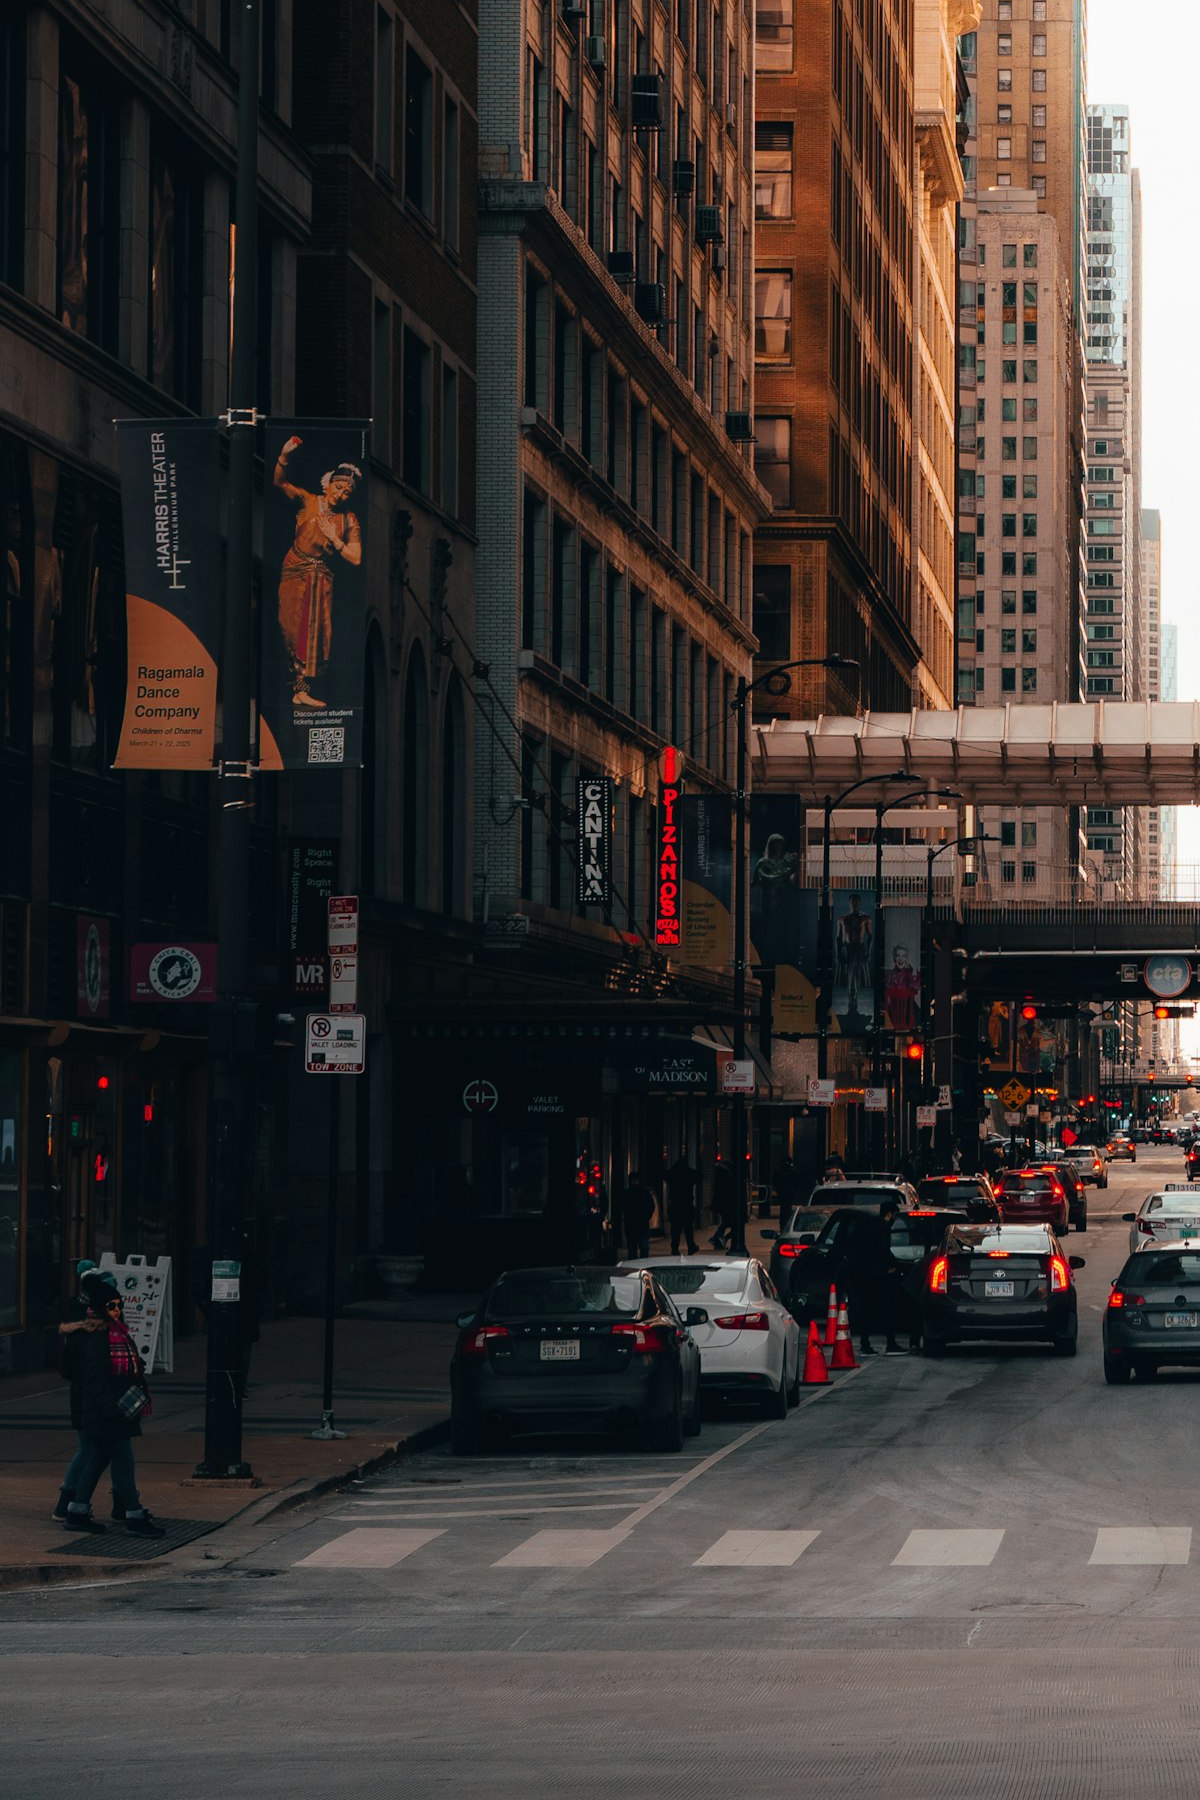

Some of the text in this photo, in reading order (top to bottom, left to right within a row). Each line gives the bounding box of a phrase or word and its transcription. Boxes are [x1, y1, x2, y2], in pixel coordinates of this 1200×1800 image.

[151, 432, 171, 568] HARRIS THEATER
[169, 462, 179, 552] MILLENNIUM PARK
[137, 665, 205, 682] Ragamala
[136, 685, 180, 699] Dance
[134, 704, 200, 721] Company
[293, 709, 354, 718] Discounted student
[131, 727, 203, 736] Children of Dharma
[584, 784, 604, 897] CANTINA
[697, 799, 706, 868] HARRIS THEATER
[307, 848, 333, 858] Right
[306, 878, 332, 888] Right
[290, 848, 301, 951] www.marcrealty.com
[656, 918, 680, 930] PIZZA
[656, 931, 680, 945] PASTA
[154, 949, 197, 965] CHIYA CHAI
[296, 964, 325, 984] MR
[1151, 965, 1184, 981] cta
[158, 986, 192, 997] CHICAGO
[310, 1063, 359, 1071] TOW ZONE
[648, 1071, 708, 1082] MADISON
[532, 1095, 559, 1104] VALET
[527, 1105, 565, 1113] PARKING
[1177, 1184, 1195, 1192] 1310
